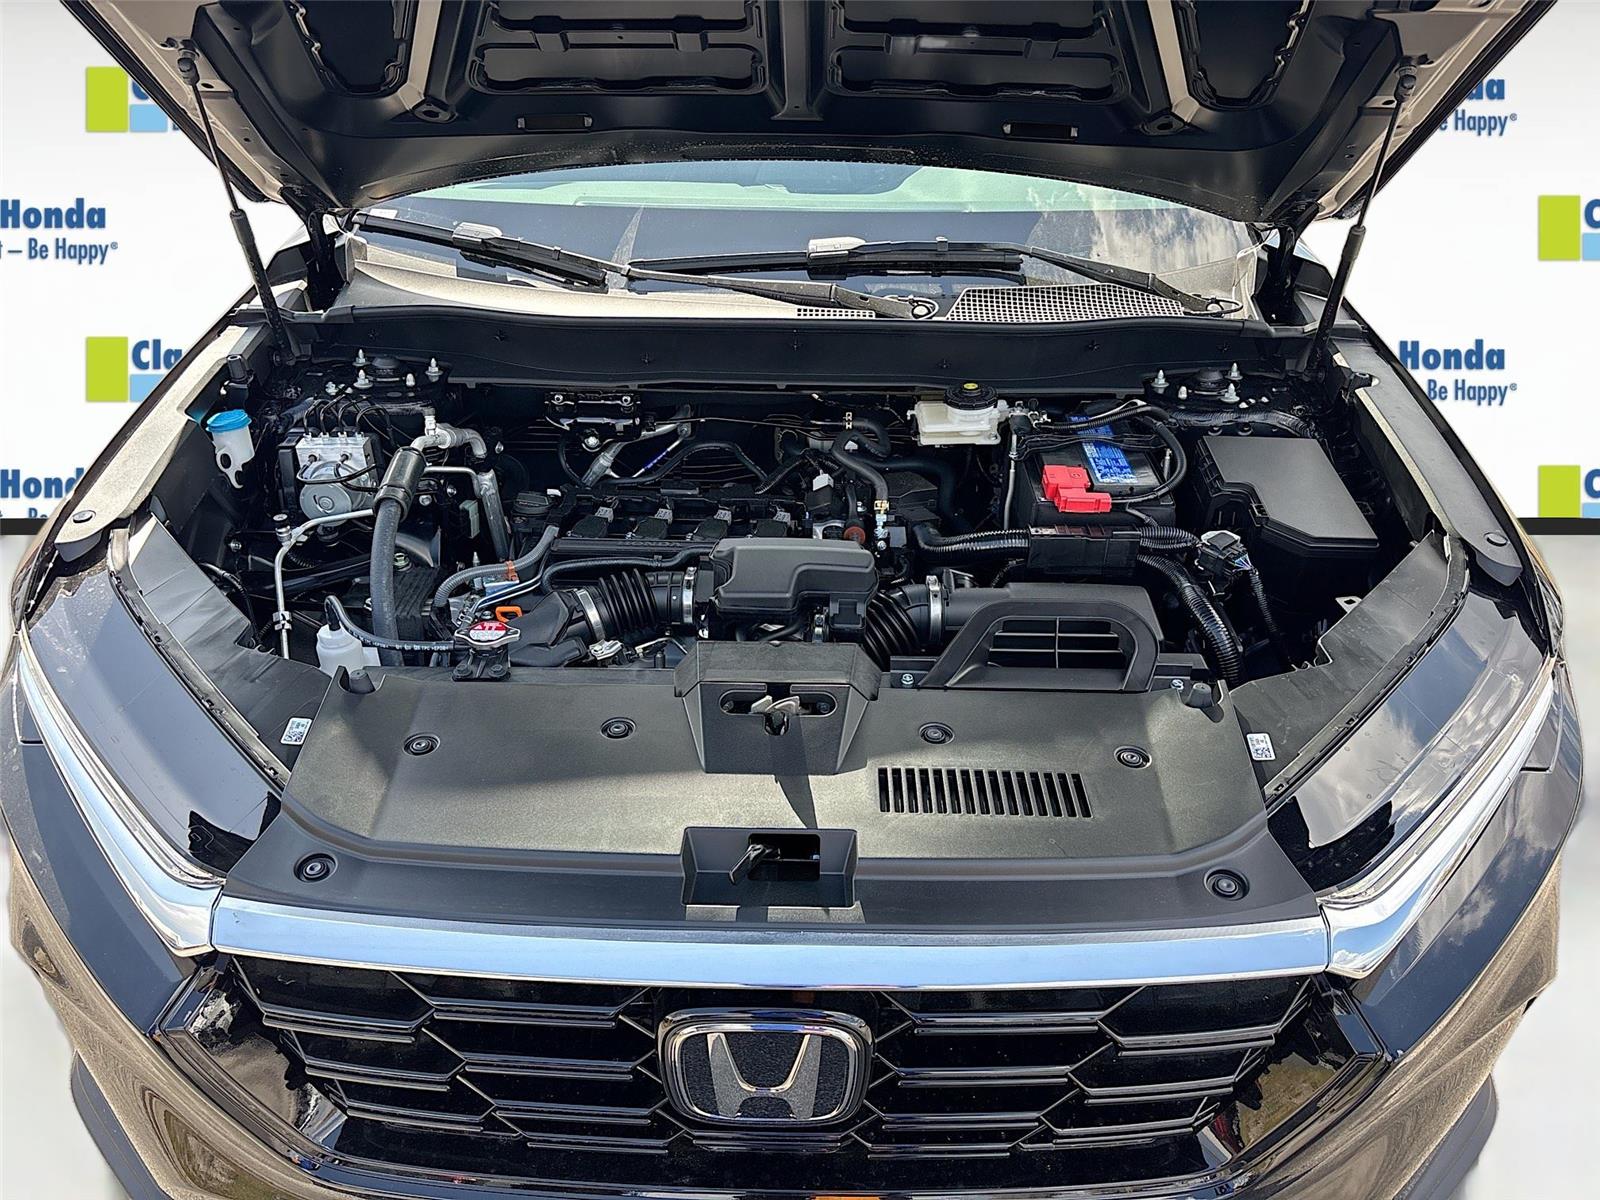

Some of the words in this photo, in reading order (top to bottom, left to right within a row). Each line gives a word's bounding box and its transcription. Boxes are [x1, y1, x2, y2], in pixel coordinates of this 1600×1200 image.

[0, 198, 106, 229] Honda
[28, 238, 49, 259] Be
[1399, 339, 1505, 370] Honda
[1428, 379, 1448, 401] Be
